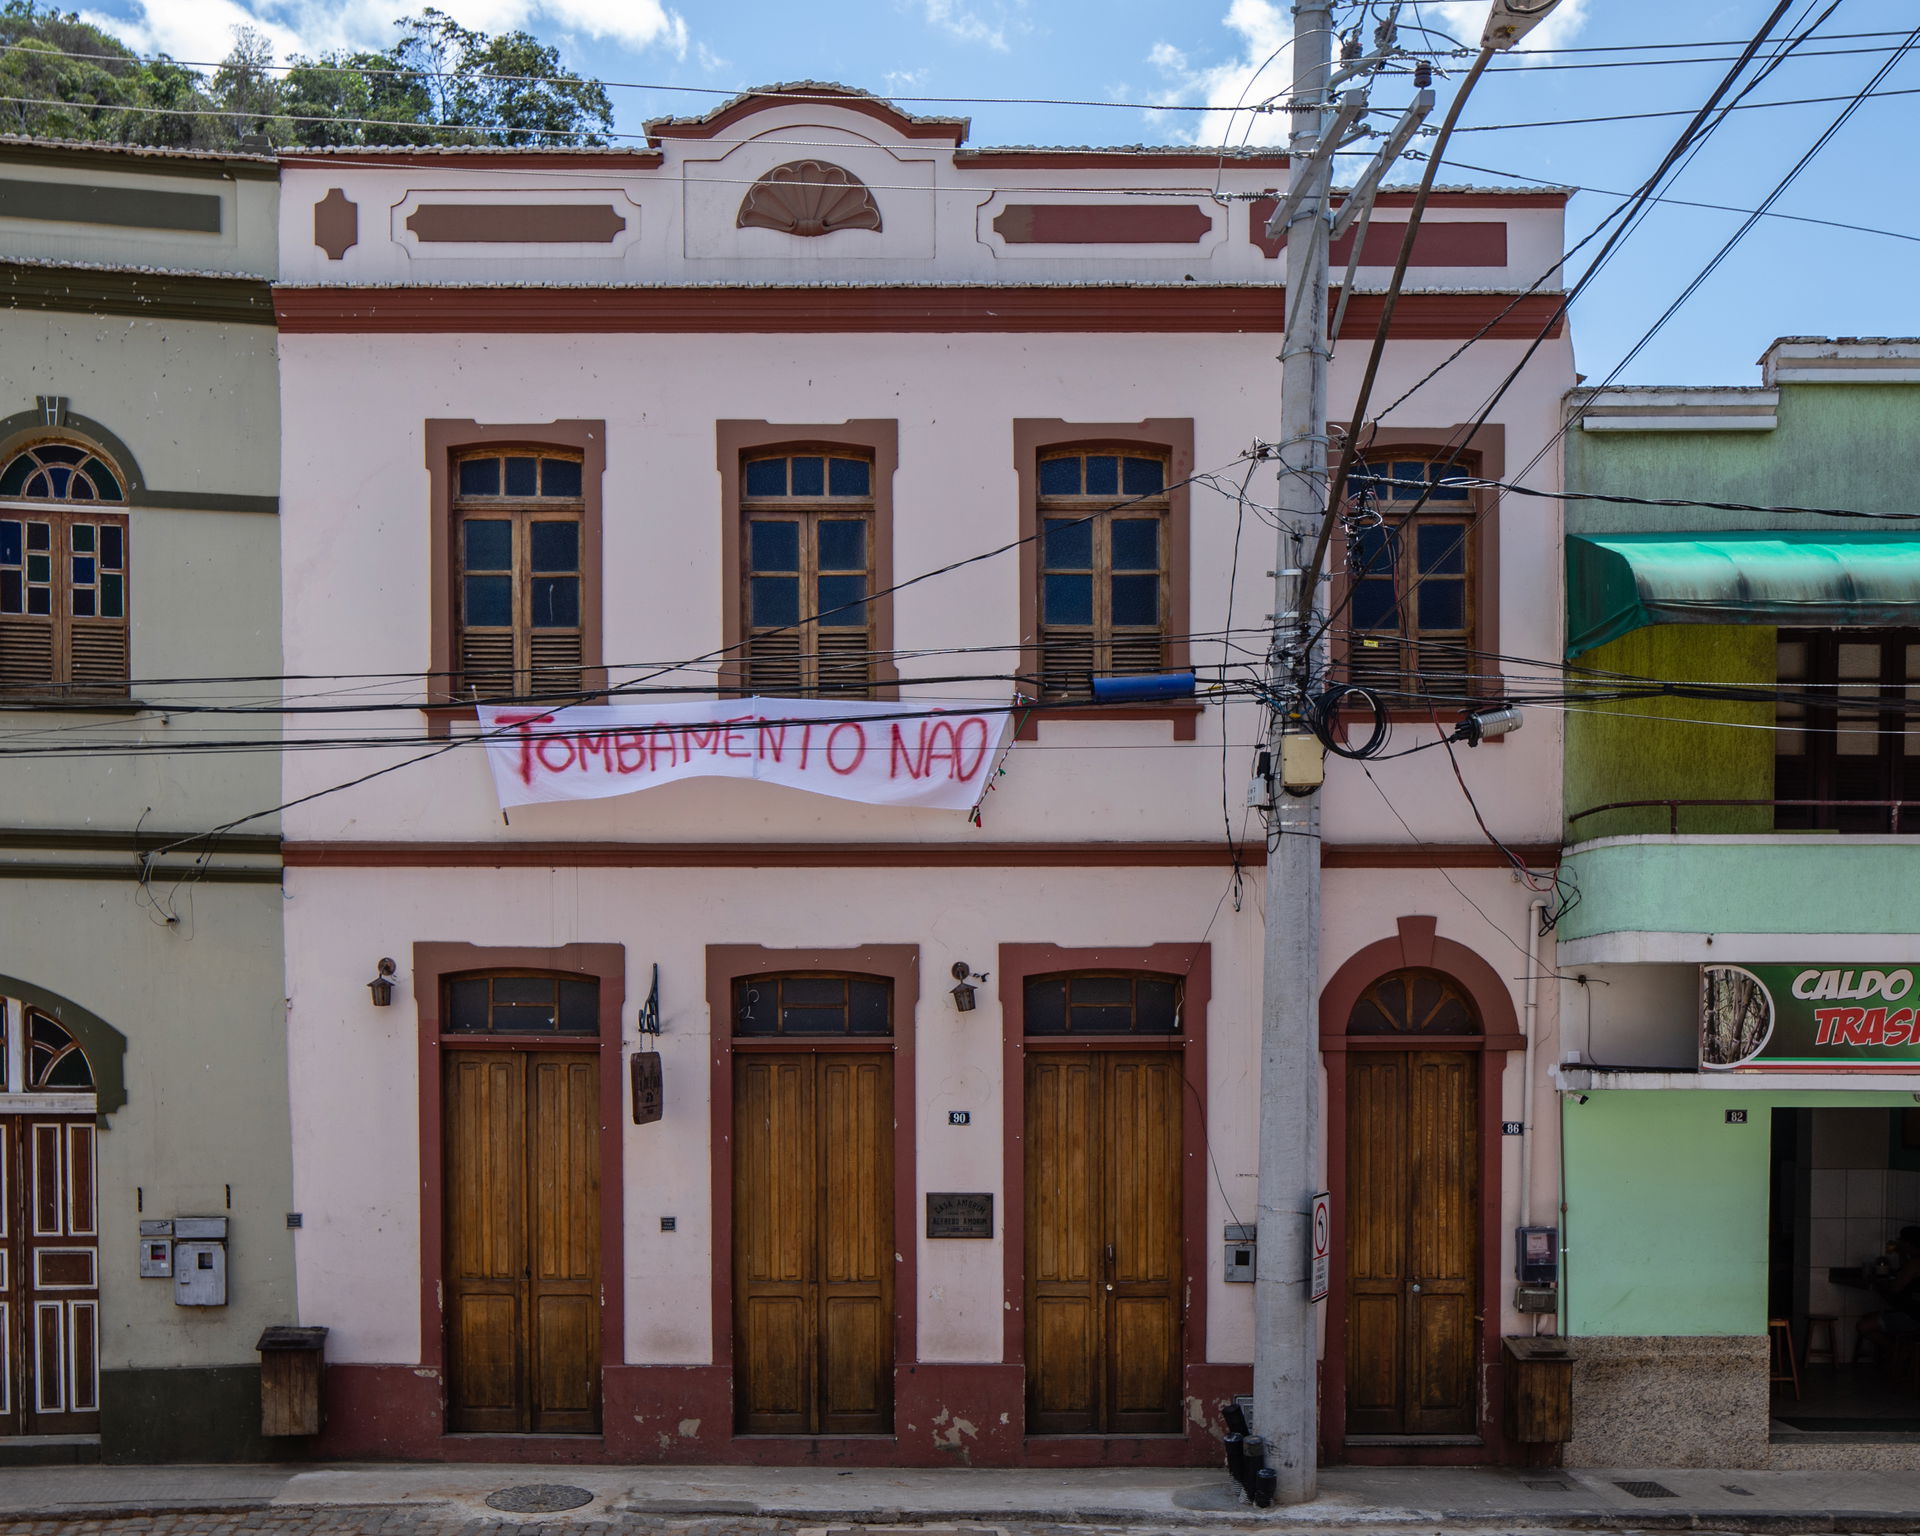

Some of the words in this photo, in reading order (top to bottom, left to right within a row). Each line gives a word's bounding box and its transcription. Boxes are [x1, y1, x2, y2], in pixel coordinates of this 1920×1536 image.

[495, 714, 866, 785] TOMBAMENTO
[1791, 968, 1914, 1002] CALDO
[953, 1112, 966, 1124] 90
[1731, 1111, 1744, 1122] 82
[1507, 1123, 1520, 1134] 86
